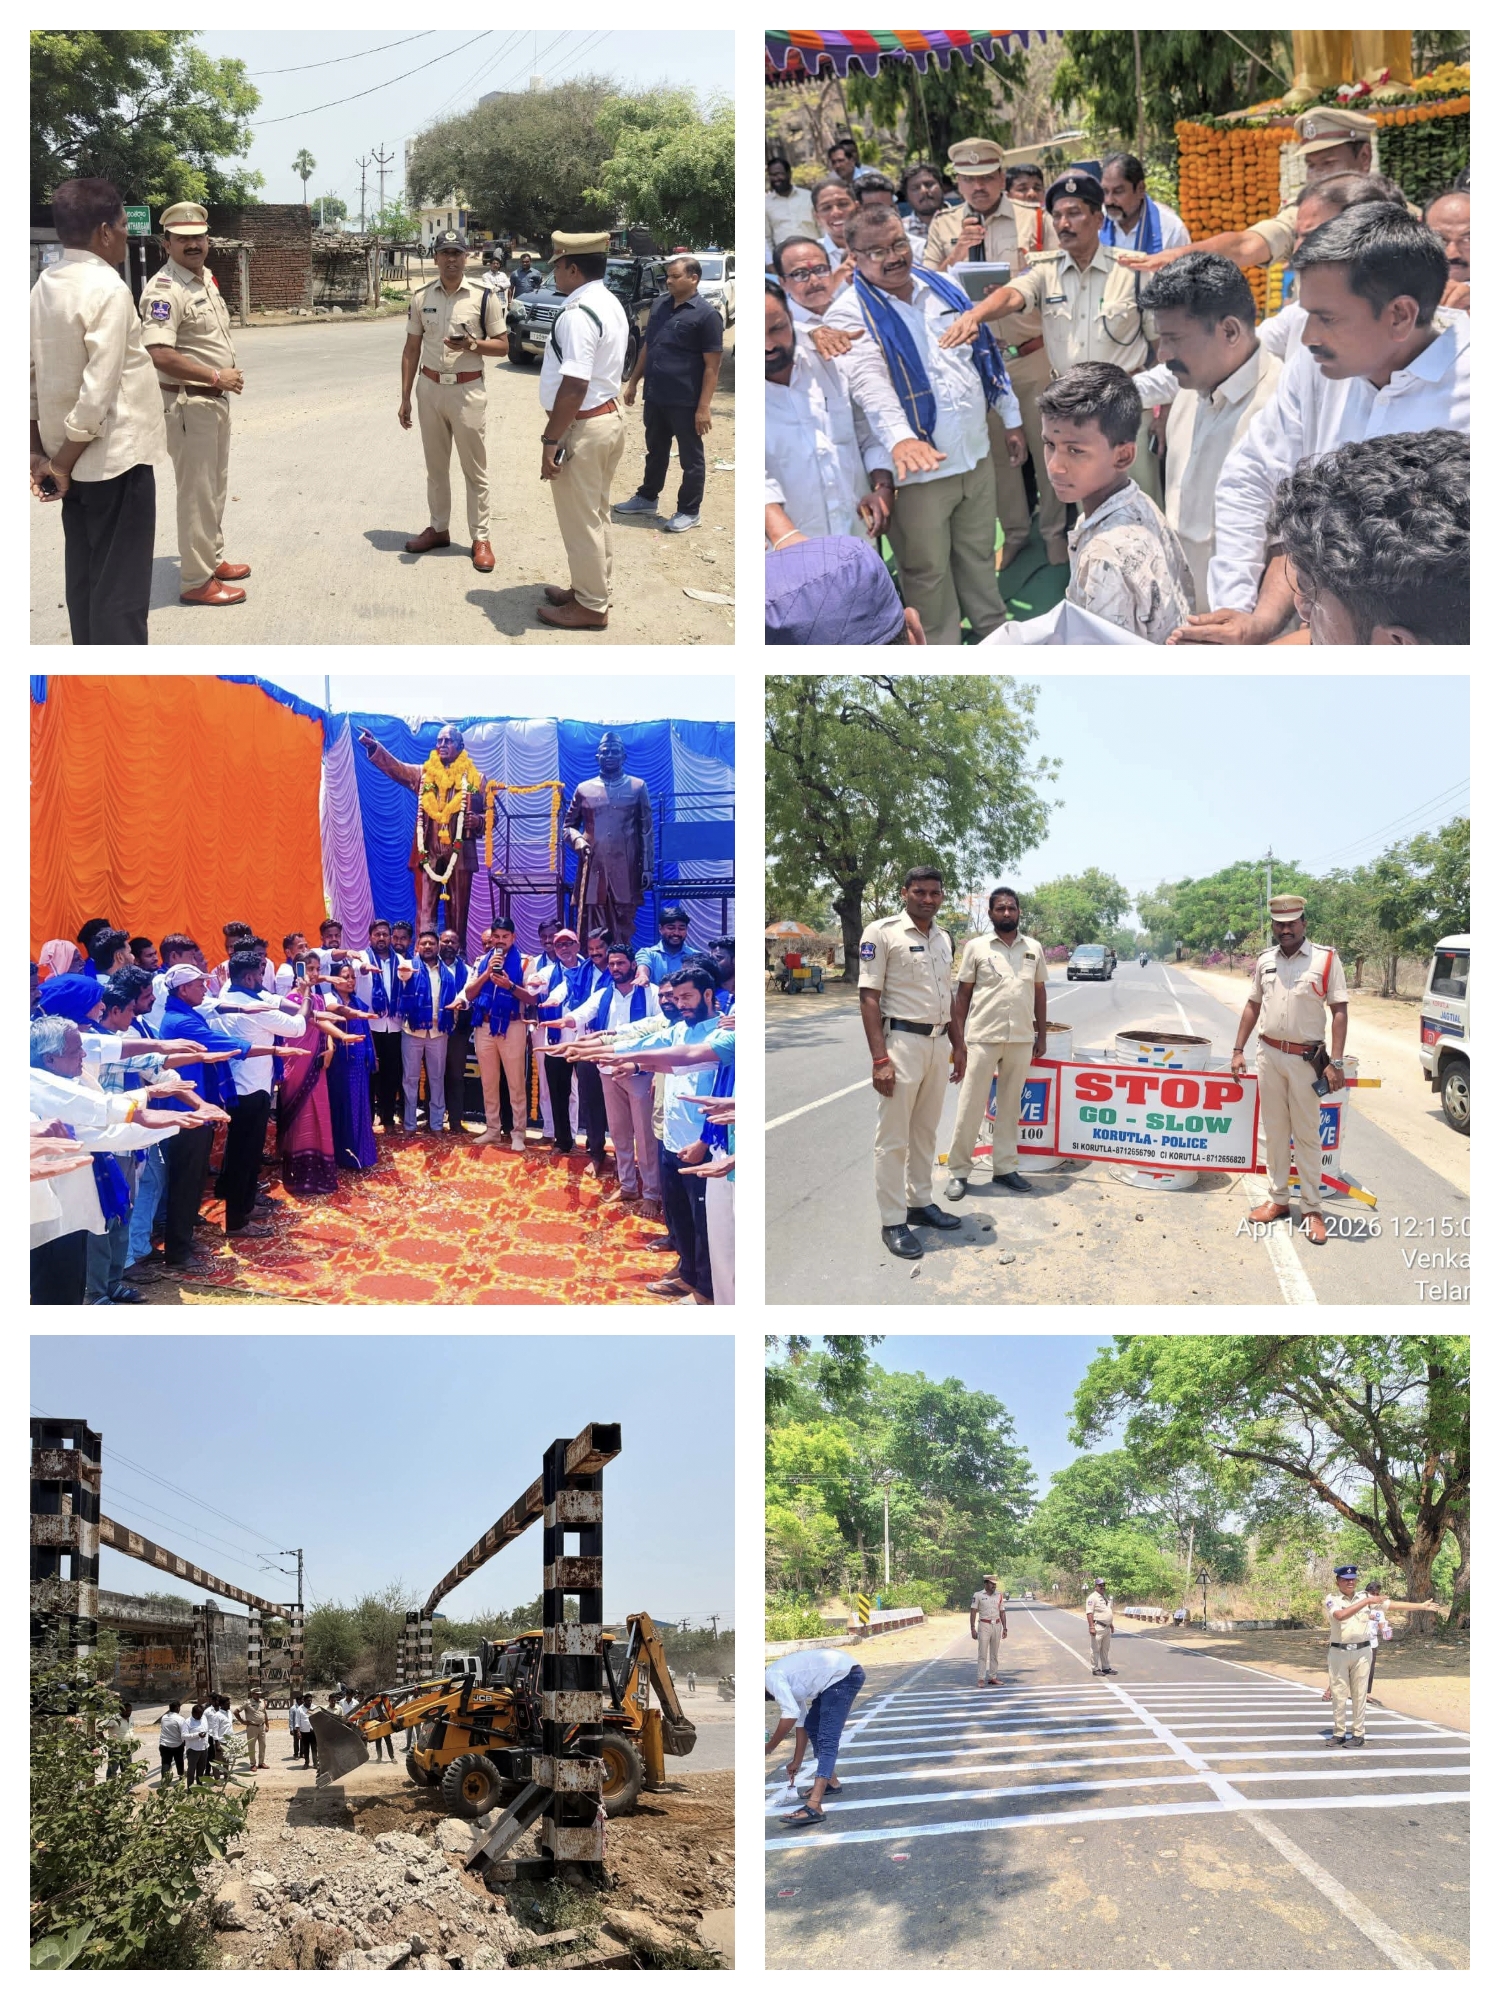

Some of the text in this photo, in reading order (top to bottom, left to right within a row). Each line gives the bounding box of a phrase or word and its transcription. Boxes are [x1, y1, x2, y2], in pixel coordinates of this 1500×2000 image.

[1440, 1011, 1462, 1023] JAGTIAL
[1075, 1073, 1244, 1110] STOP
[1079, 1106, 1117, 1125] GO
[1146, 1113, 1233, 1134] SLOW
[1021, 1128, 1043, 1140] 100
[1161, 1135, 1208, 1150] POLICE
[1072, 1142, 1079, 1150] SI
[1160, 1151, 1168, 1159] CI
[1168, 1152, 1201, 1162] KORUTLA
[1206, 1154, 1246, 1164] 8712656820
[473, 1694, 493, 1702] JCB
